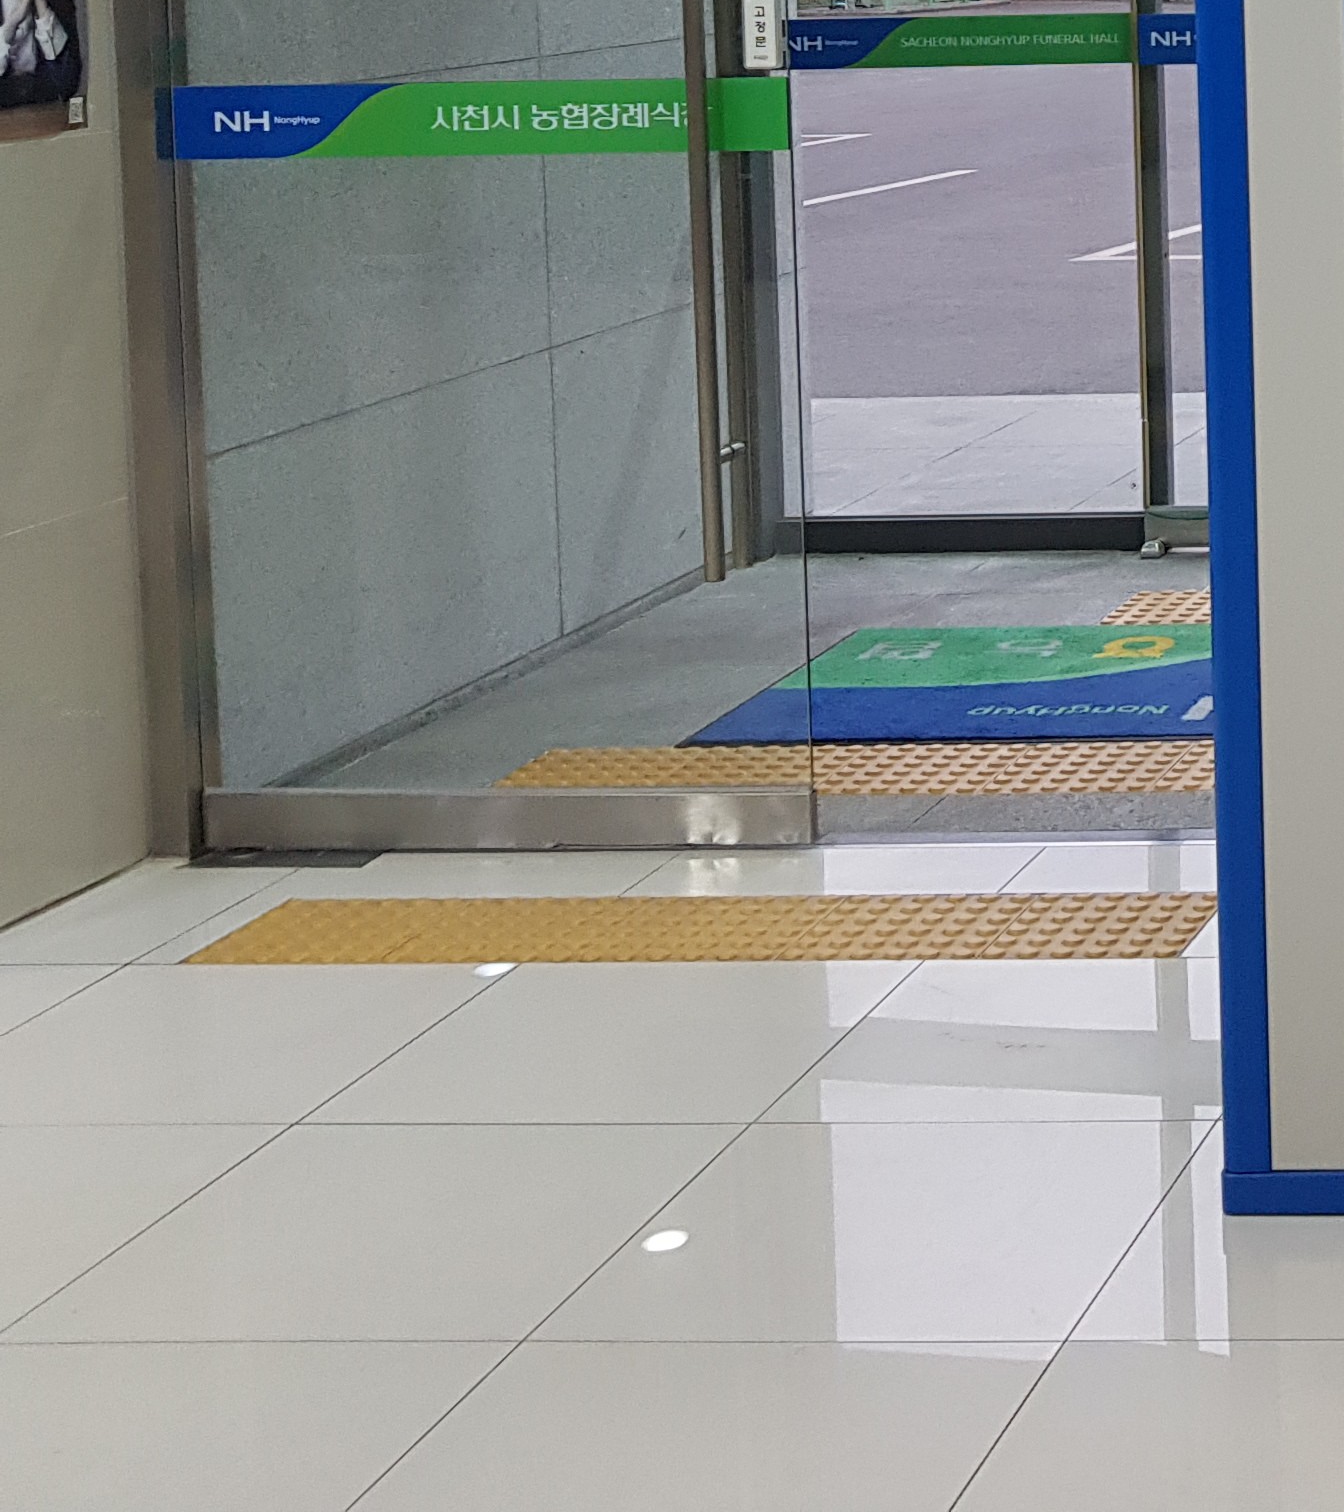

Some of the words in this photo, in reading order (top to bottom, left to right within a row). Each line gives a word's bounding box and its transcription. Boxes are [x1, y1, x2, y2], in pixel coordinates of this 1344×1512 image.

[755, 6, 767, 48] 고정문
[901, 35, 958, 48] SACHEON
[961, 34, 1030, 47] NONGHYUP
[1033, 33, 1087, 46] FUNERAL
[1090, 33, 1119, 45] HALL
[1151, 31, 1191, 46] NH
[214, 110, 270, 132] NH
[430, 104, 520, 131] 사천시
[967, 704, 1169, 716] NongHyup
